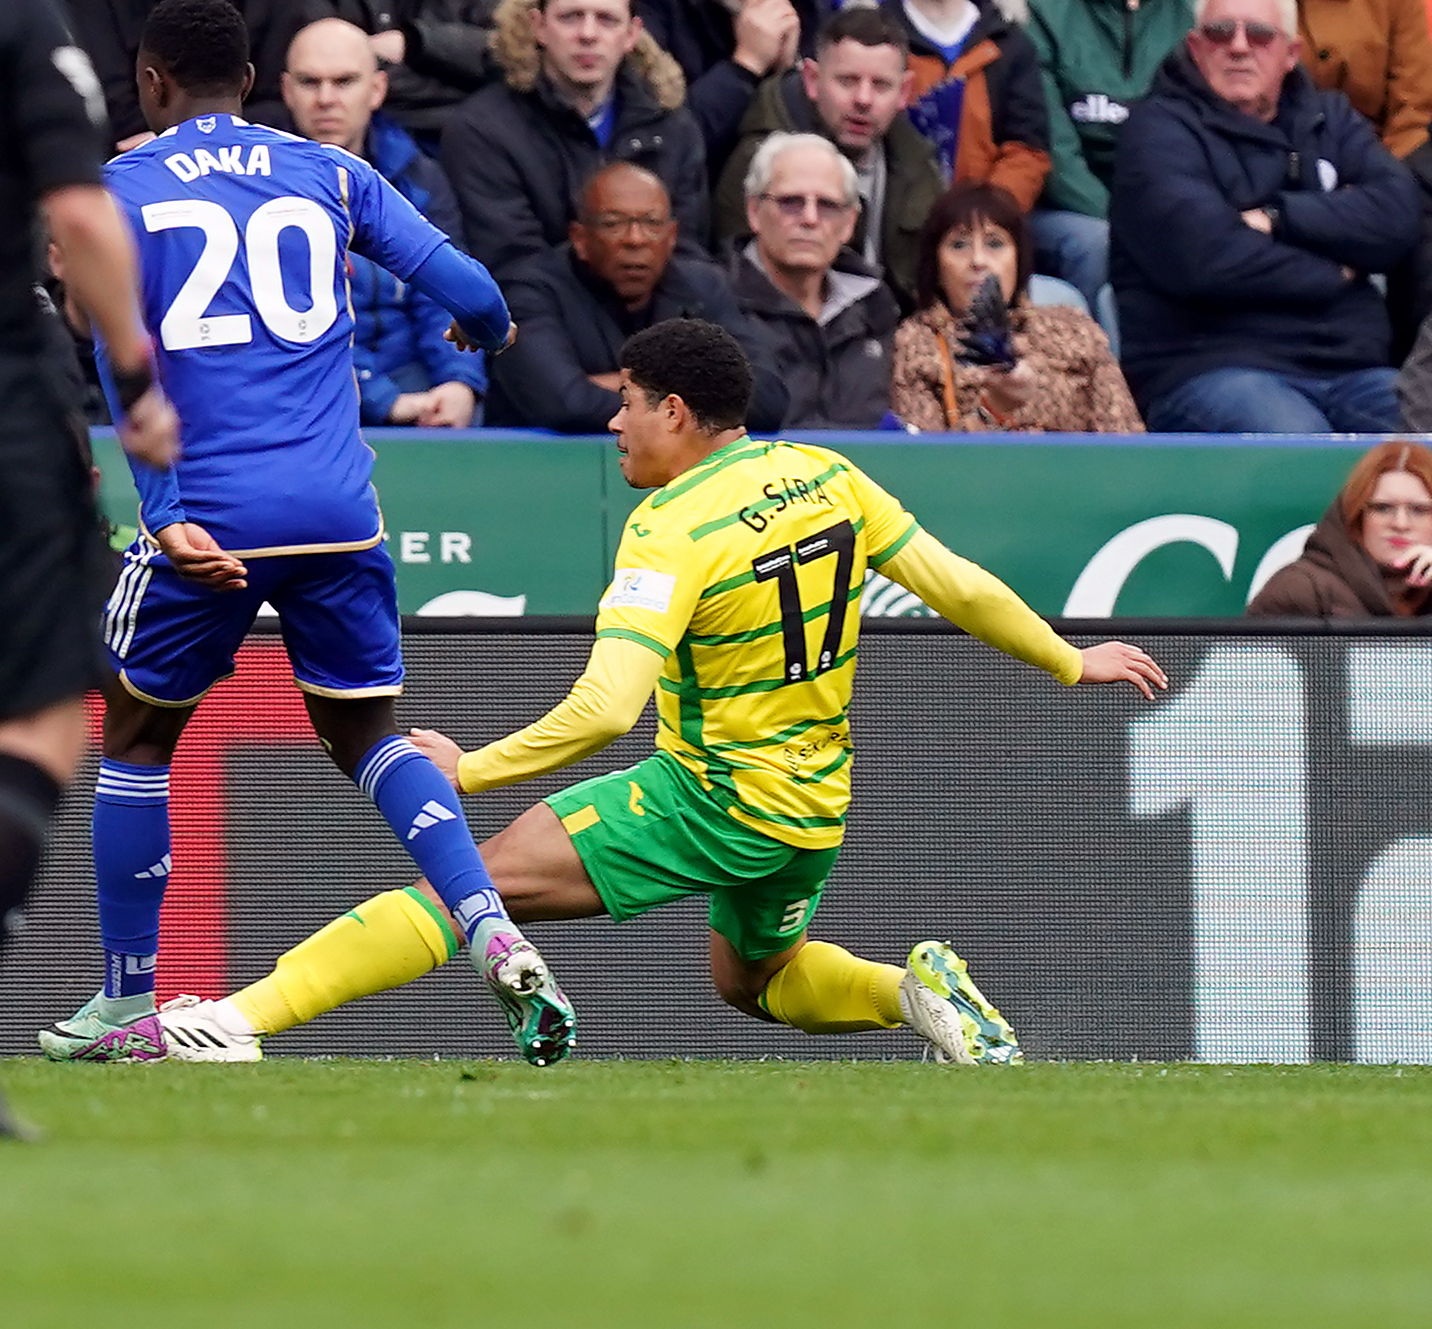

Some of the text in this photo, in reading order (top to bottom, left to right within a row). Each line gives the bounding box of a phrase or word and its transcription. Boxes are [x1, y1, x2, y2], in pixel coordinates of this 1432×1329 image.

[164, 145, 272, 183] DAKA
[141, 196, 338, 351] 20
[752, 519, 855, 685] 17
